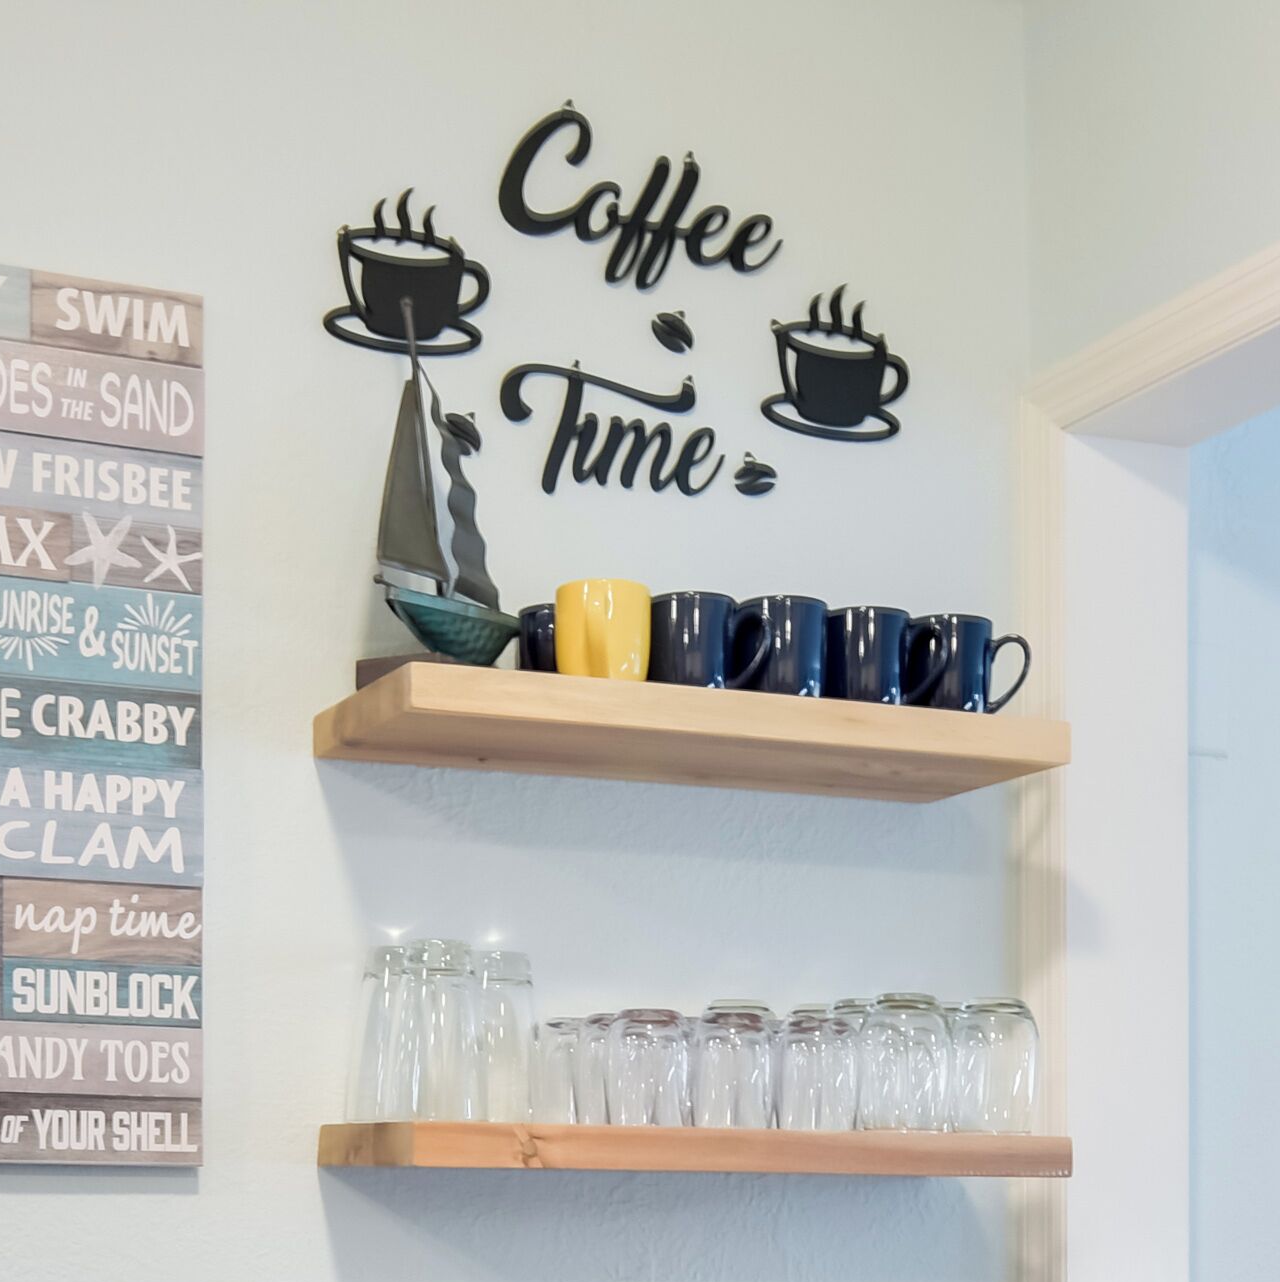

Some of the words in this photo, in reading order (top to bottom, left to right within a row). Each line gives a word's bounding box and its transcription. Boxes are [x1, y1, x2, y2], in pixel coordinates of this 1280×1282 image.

[498, 108, 784, 290] Coffee
[55, 286, 190, 348] SWIM
[67, 367, 87, 389] IN
[100, 372, 194, 437] SAND
[60, 398, 93, 422] THE
[500, 361, 725, 496] Time
[32, 451, 192, 511] FRISBEE
[79, 606, 106, 658] &
[111, 630, 199, 676] SUNSET
[31, 694, 196, 746] CRABBY
[0, 766, 31, 808] A
[43, 769, 185, 819] HAPPY
[14, 903, 98, 954] nap
[108, 894, 202, 941] time
[12, 967, 200, 1020] SUNBLOCK
[100, 1039, 190, 1085] TOES
[0, 1114, 29, 1144] OF
[32, 1109, 106, 1151] YOUR
[111, 1111, 198, 1153] SHELL
